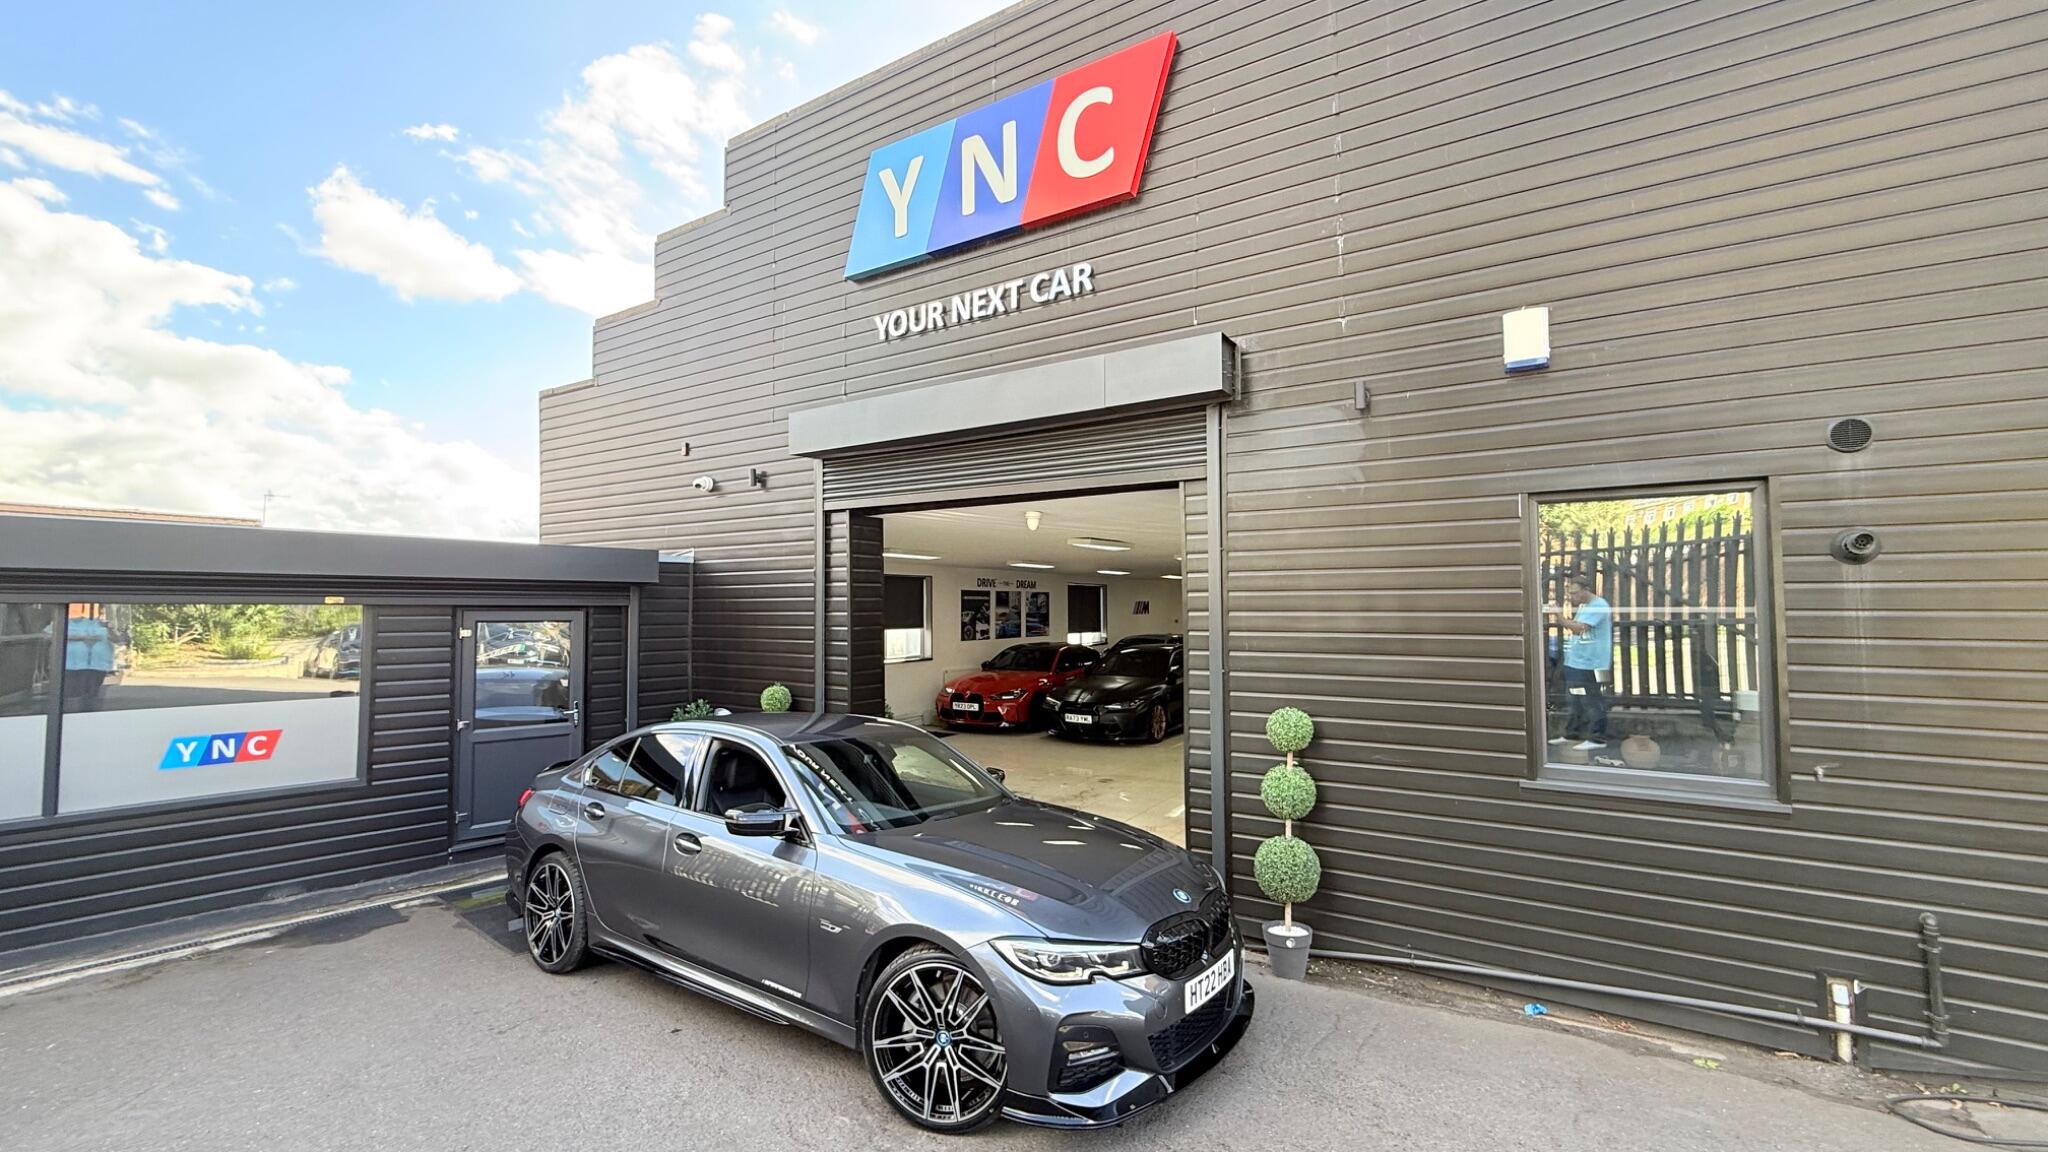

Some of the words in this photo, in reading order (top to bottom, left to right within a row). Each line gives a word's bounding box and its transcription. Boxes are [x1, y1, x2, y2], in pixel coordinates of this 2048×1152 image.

[878, 86, 1115, 238] YNC
[873, 301, 944, 341] YOUR
[951, 278, 1024, 323] NEXT
[1029, 262, 1094, 303] CAR
[976, 577, 997, 588] DRIVE
[1015, 579, 1037, 589] DREAM
[176, 736, 267, 762] YNC
[1189, 970, 1216, 1007] HT22
